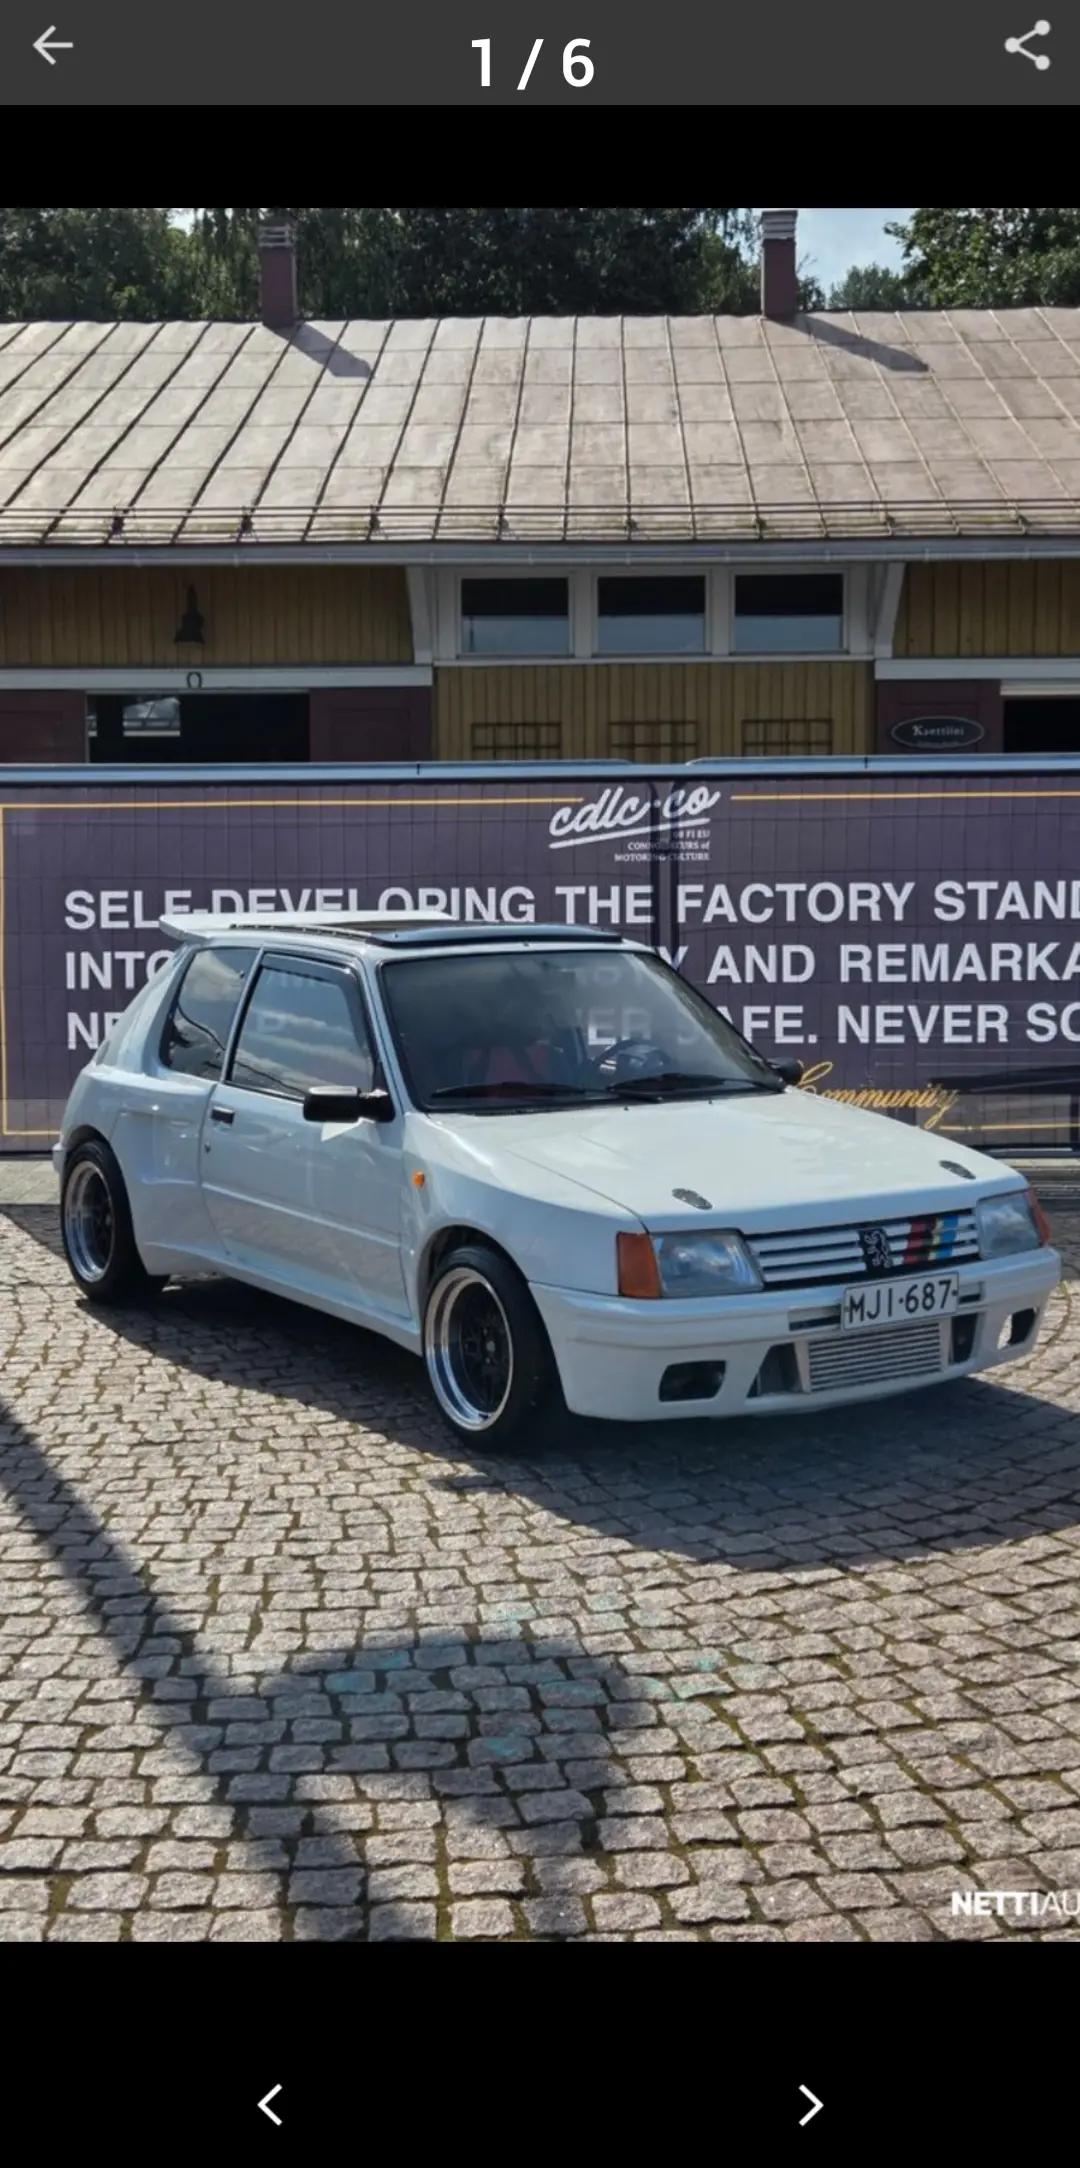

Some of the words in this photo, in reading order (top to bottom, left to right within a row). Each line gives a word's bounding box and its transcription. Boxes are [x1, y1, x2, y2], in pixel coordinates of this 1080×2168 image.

[555, 884, 653, 924] THE
[676, 881, 915, 923] FACTORY
[707, 944, 815, 984] AND
[838, 1005, 1008, 1043] NEVER
